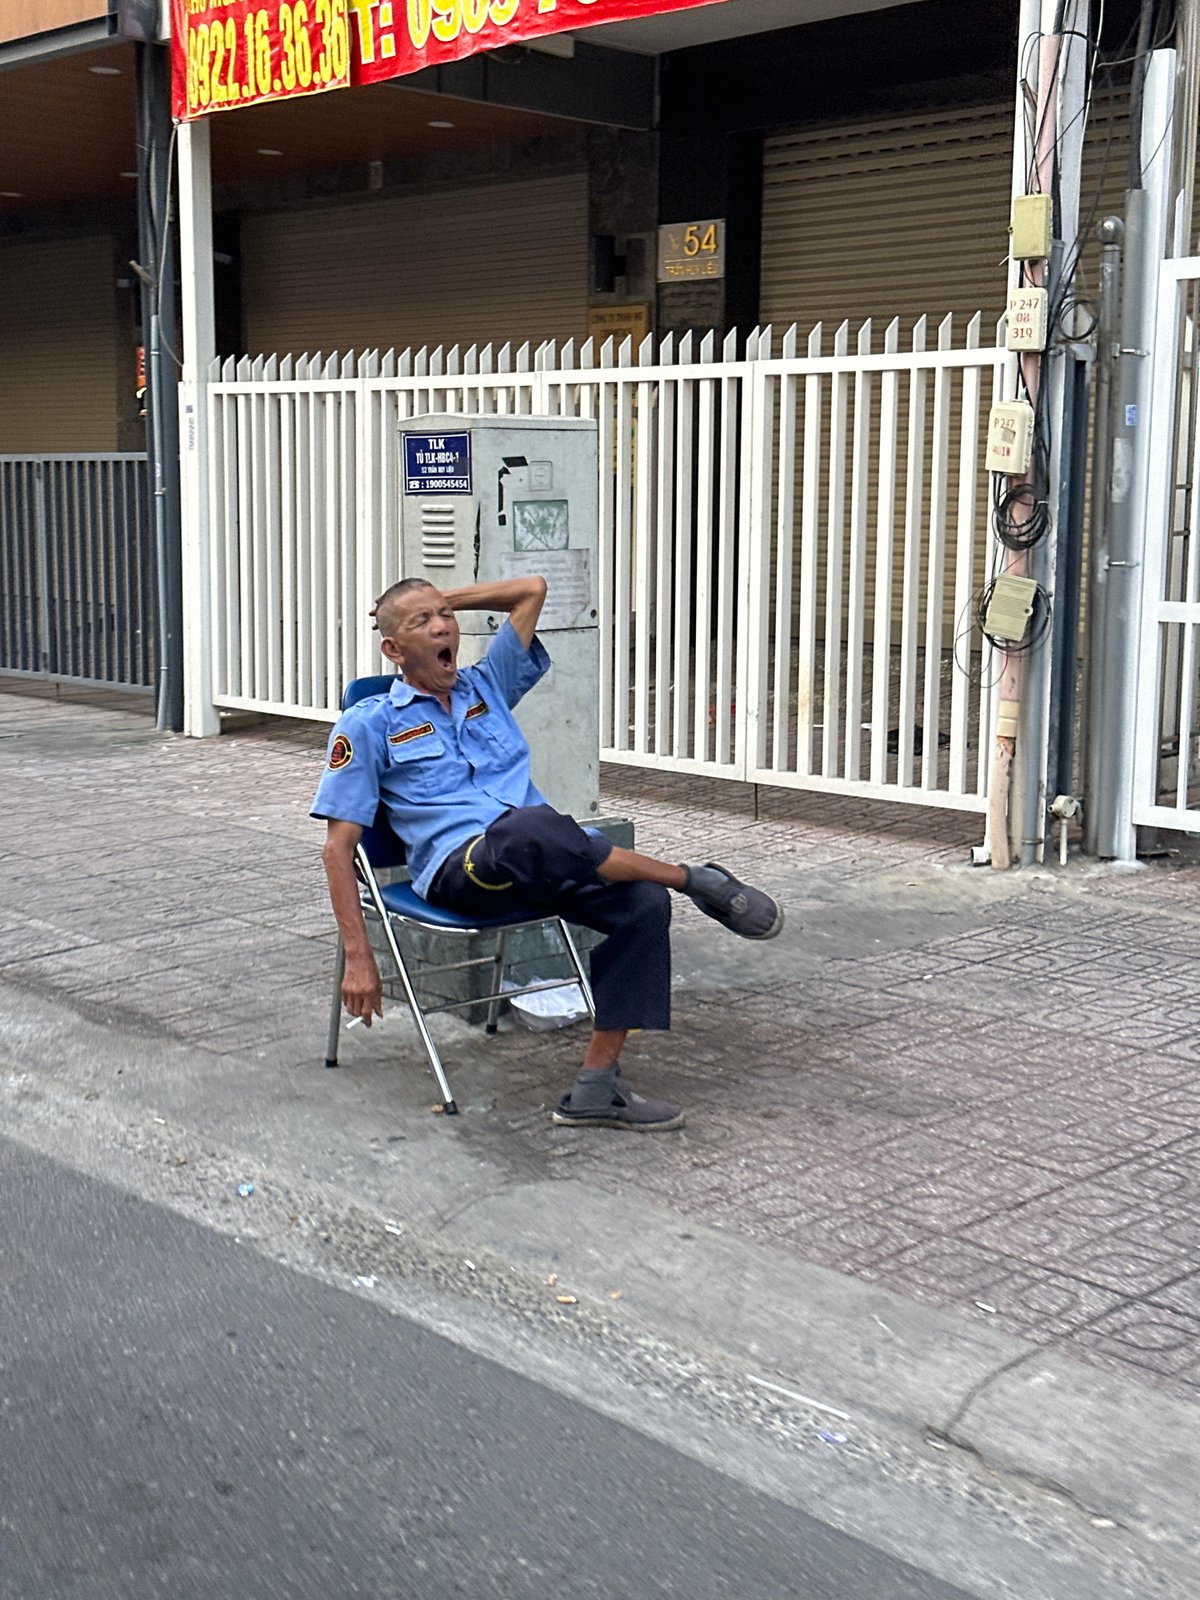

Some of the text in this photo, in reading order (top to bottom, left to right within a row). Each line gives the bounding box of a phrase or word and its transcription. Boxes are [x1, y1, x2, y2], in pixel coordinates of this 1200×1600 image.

[189, 0, 347, 109] 0922.16.36.36
[684, 224, 717, 256] 54
[1019, 297, 1040, 310] 247
[993, 417, 1015, 429] P 247
[428, 438, 445, 450] TLK
[426, 479, 468, 489] 1900545454
